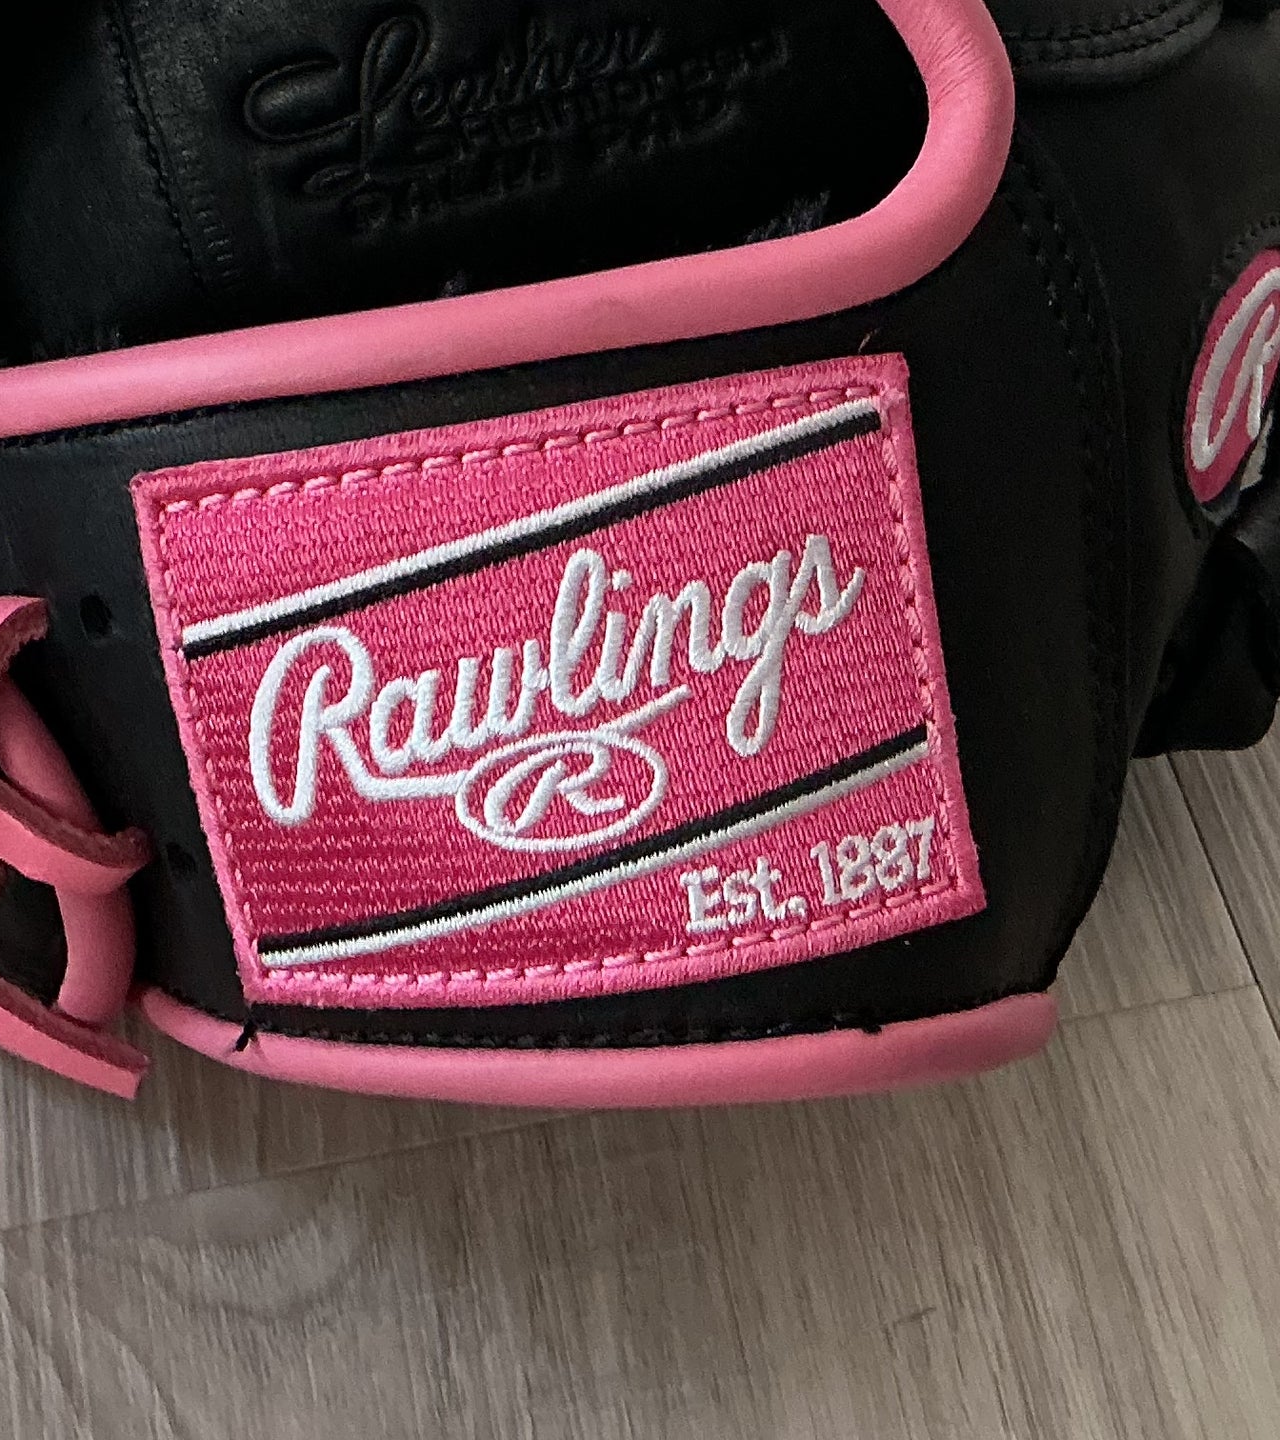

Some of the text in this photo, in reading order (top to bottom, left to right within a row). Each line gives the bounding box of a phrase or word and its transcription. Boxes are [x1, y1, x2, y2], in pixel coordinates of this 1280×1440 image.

[242, 10, 665, 200] Leather
[249, 533, 865, 827] Rawlings
[480, 740, 625, 838] R
[680, 816, 940, 933] Est. 1887
